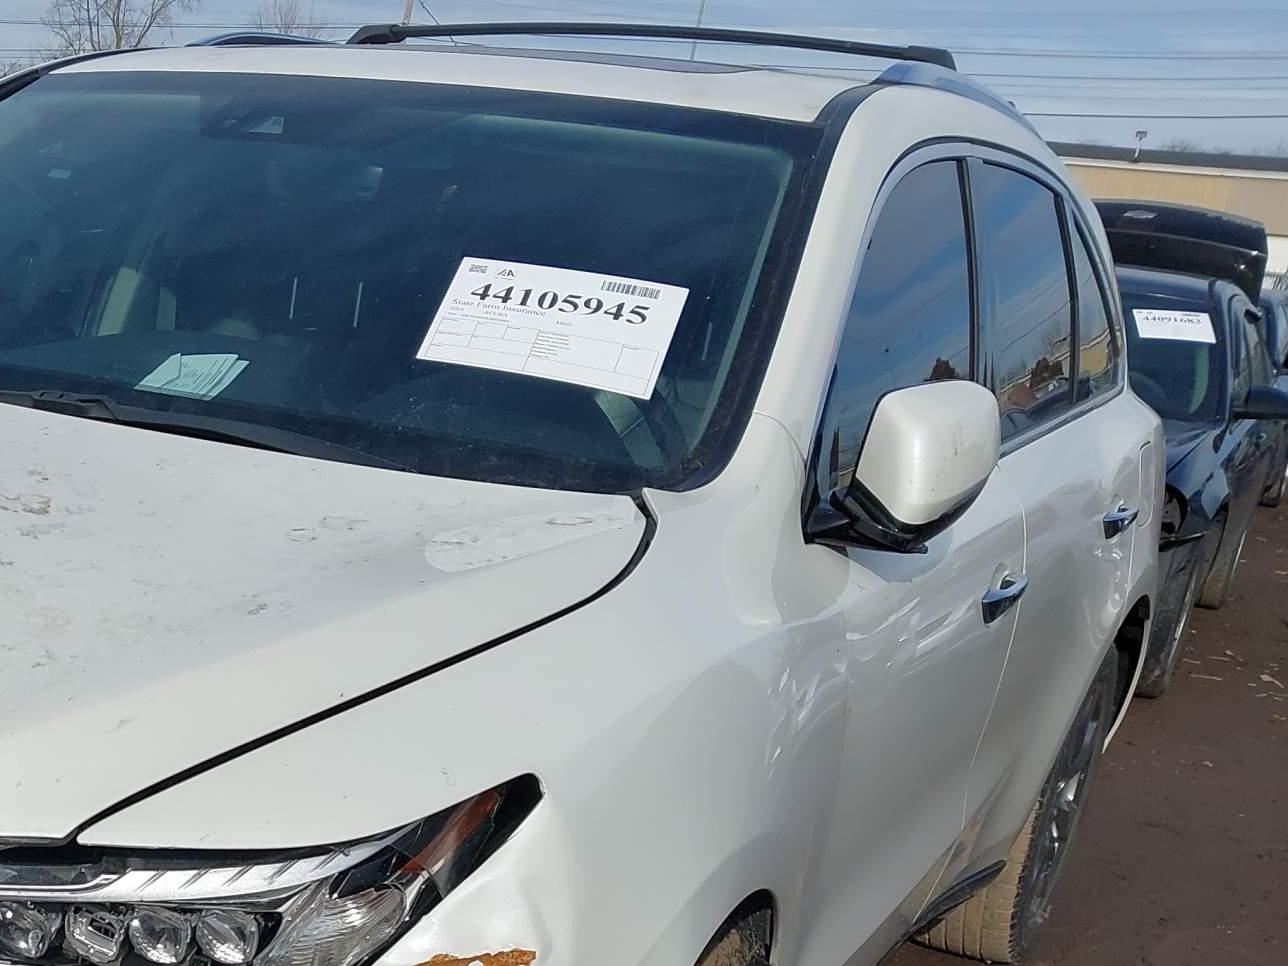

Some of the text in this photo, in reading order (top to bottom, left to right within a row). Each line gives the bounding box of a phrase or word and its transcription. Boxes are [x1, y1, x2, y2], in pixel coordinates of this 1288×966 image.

[452, 298, 475, 307] State
[477, 302, 500, 310] Farm
[502, 305, 546, 317] Insurance
[470, 282, 650, 325] 44105945
